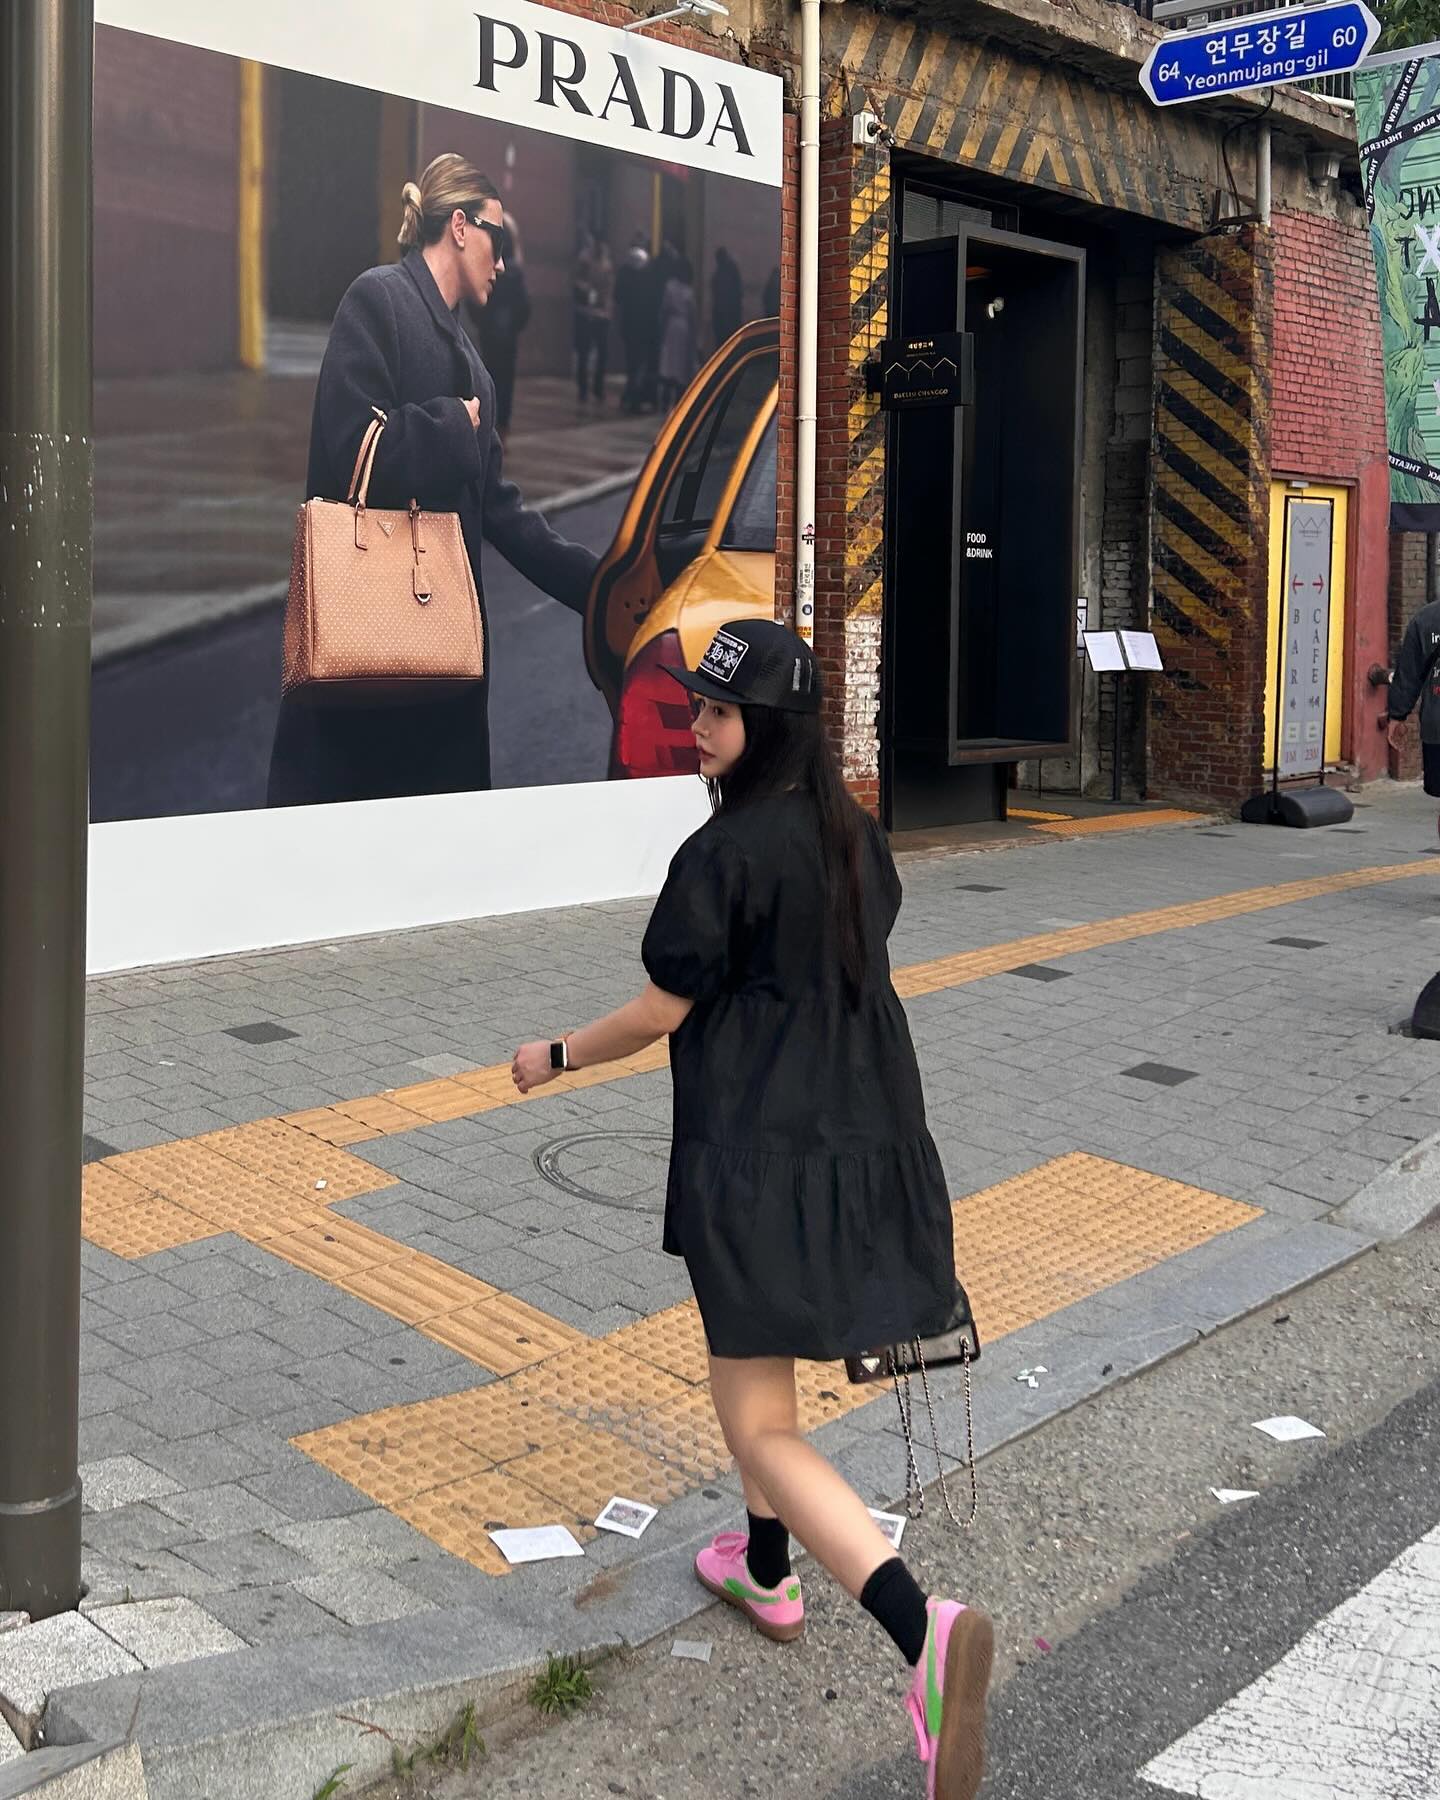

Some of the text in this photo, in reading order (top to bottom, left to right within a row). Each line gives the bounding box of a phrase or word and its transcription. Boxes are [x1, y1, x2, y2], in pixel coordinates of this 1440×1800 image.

[1205, 19, 1306, 66] 연무장길
[1331, 26, 1357, 49] 60
[473, 13, 755, 157] PRADA
[1158, 61, 1180, 83] 64
[1184, 48, 1328, 92] Yeonmujang-gil
[966, 547, 993, 559] &DRINK
[967, 532, 987, 543] FOOD
[1291, 608, 1300, 685] BAR
[1311, 607, 1321, 684] CAFE
